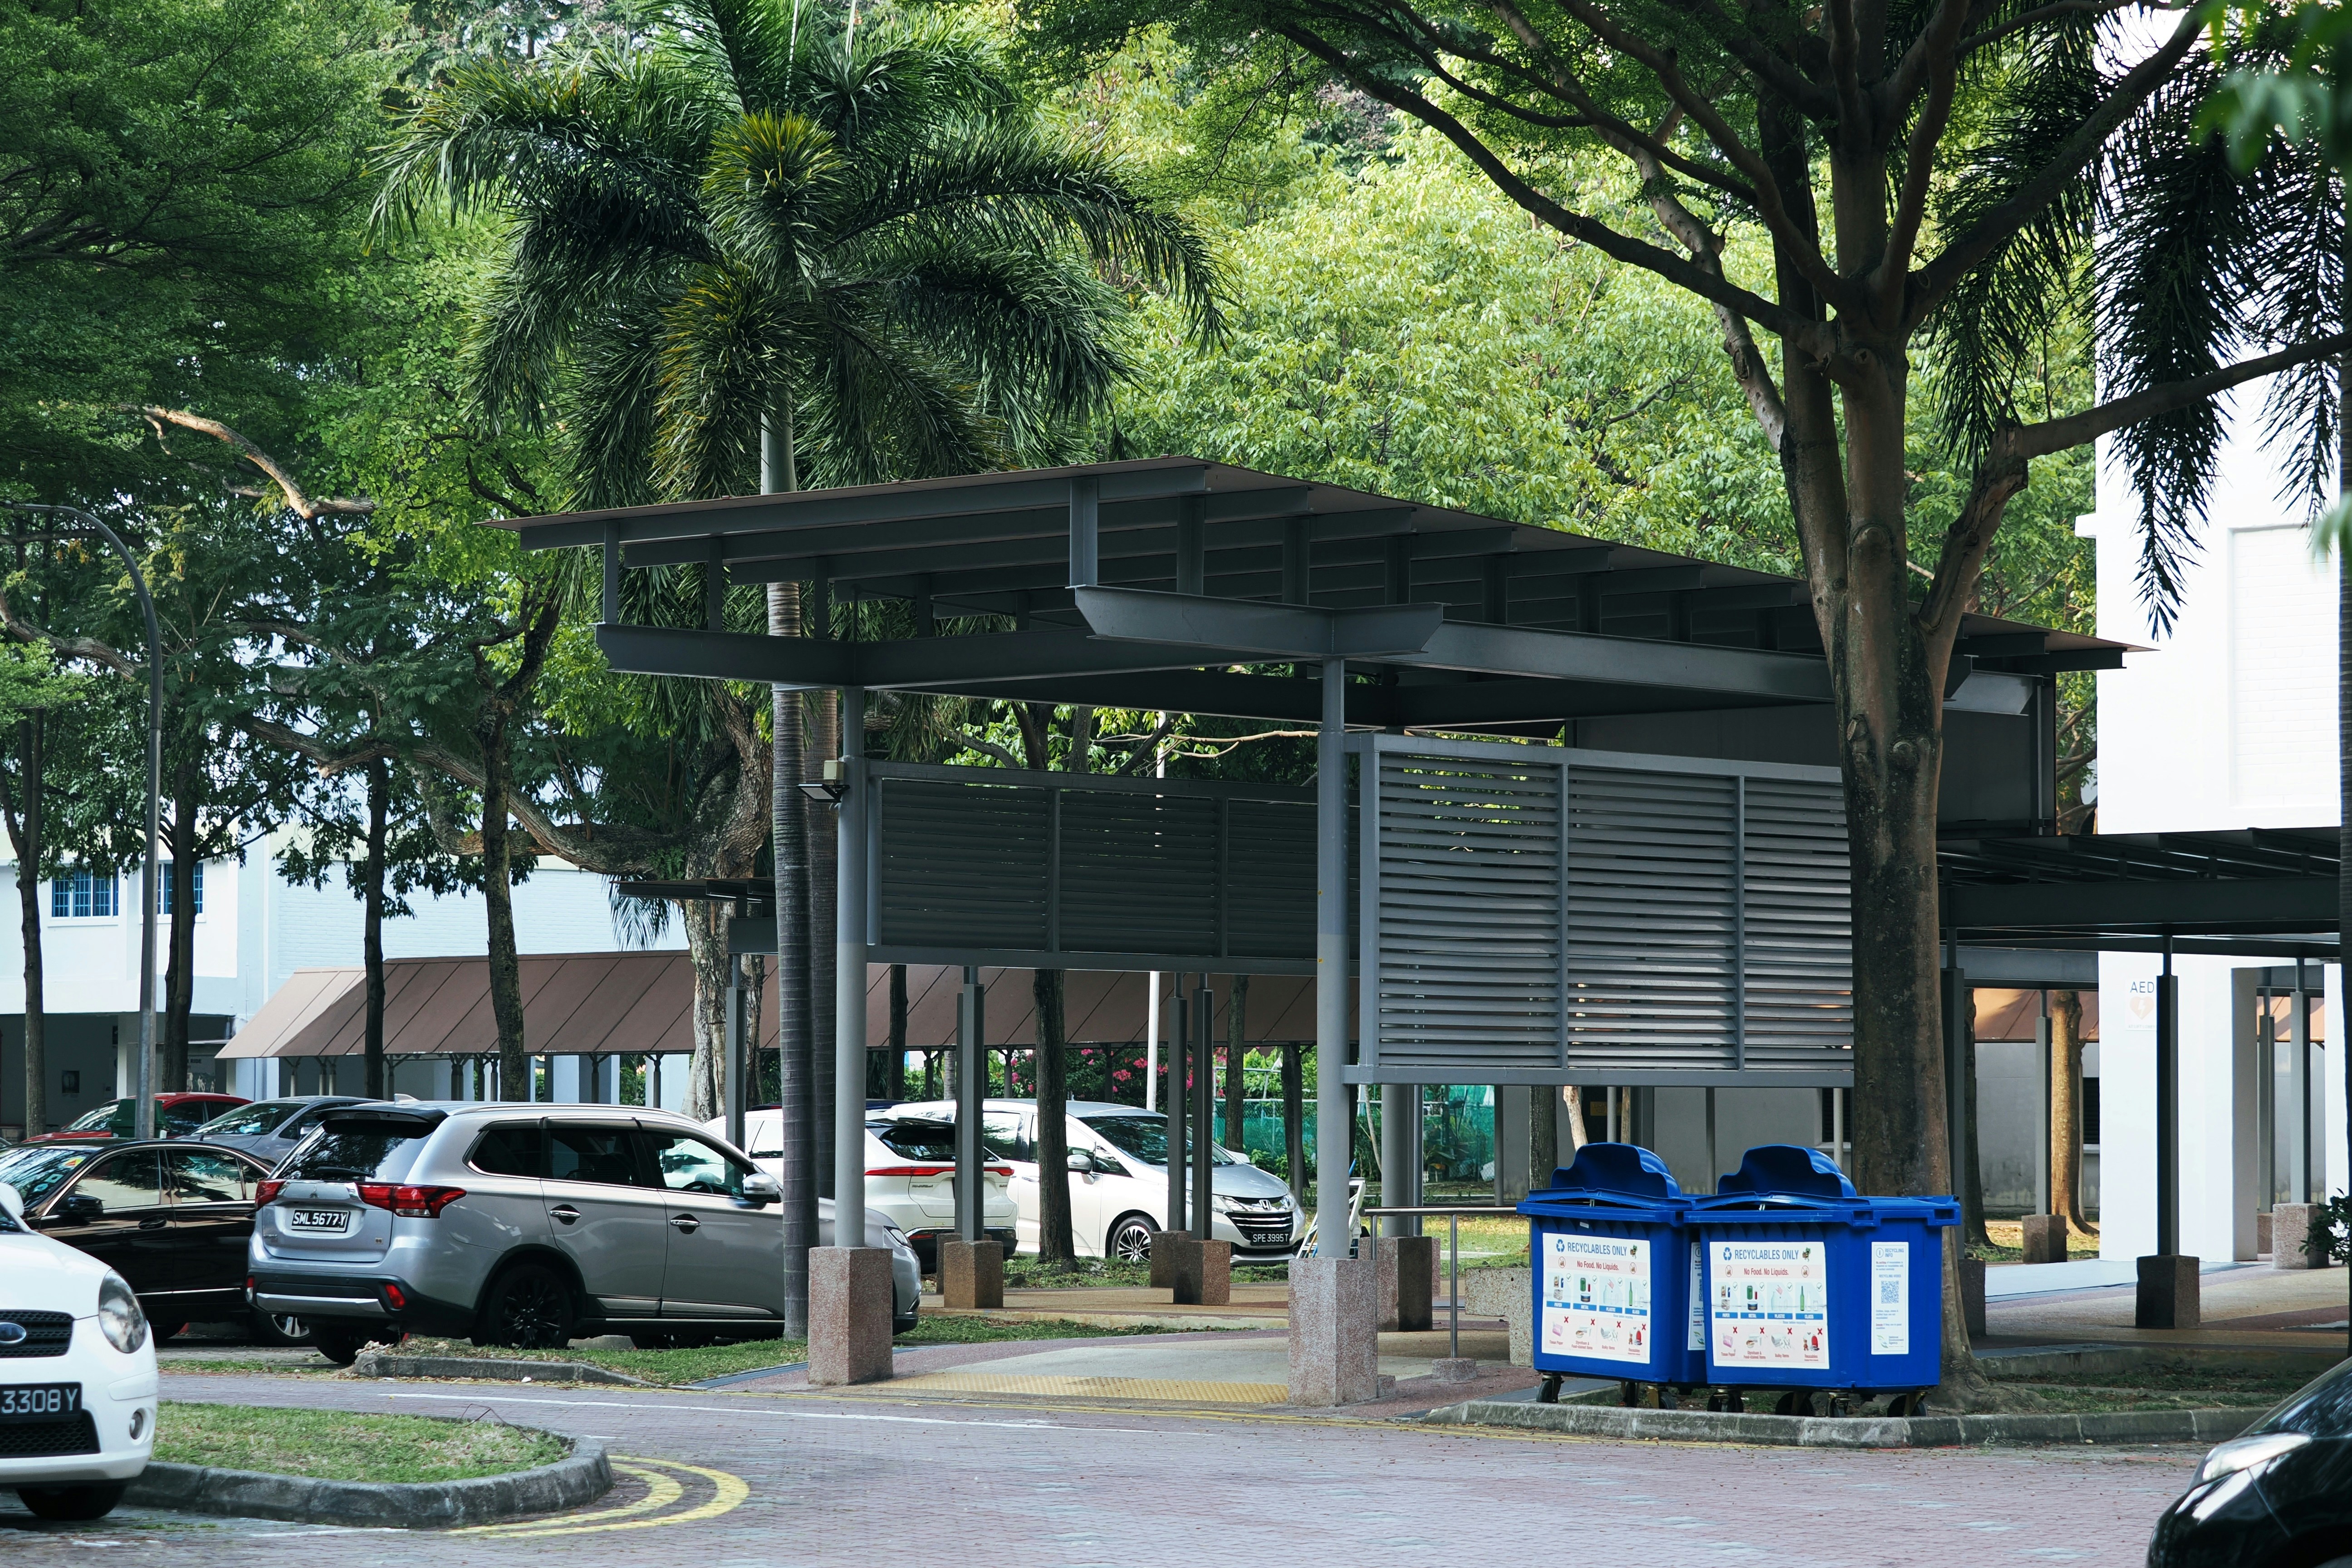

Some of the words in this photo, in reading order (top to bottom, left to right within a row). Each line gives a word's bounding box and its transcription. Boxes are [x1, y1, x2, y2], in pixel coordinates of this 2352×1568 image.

[2130, 981, 2154, 993] AED
[1568, 1242, 1611, 1255] RECYCLABLES
[1612, 1245, 1627, 1256] ONLY
[1735, 1250, 1780, 1259] RECYCLABLES
[1782, 1250, 1799, 1259] ONLY
[1602, 1262, 1619, 1271] Liquids.
[1771, 1268, 1789, 1277] Liquids.
[1, 1389, 61, 1413] 3308
